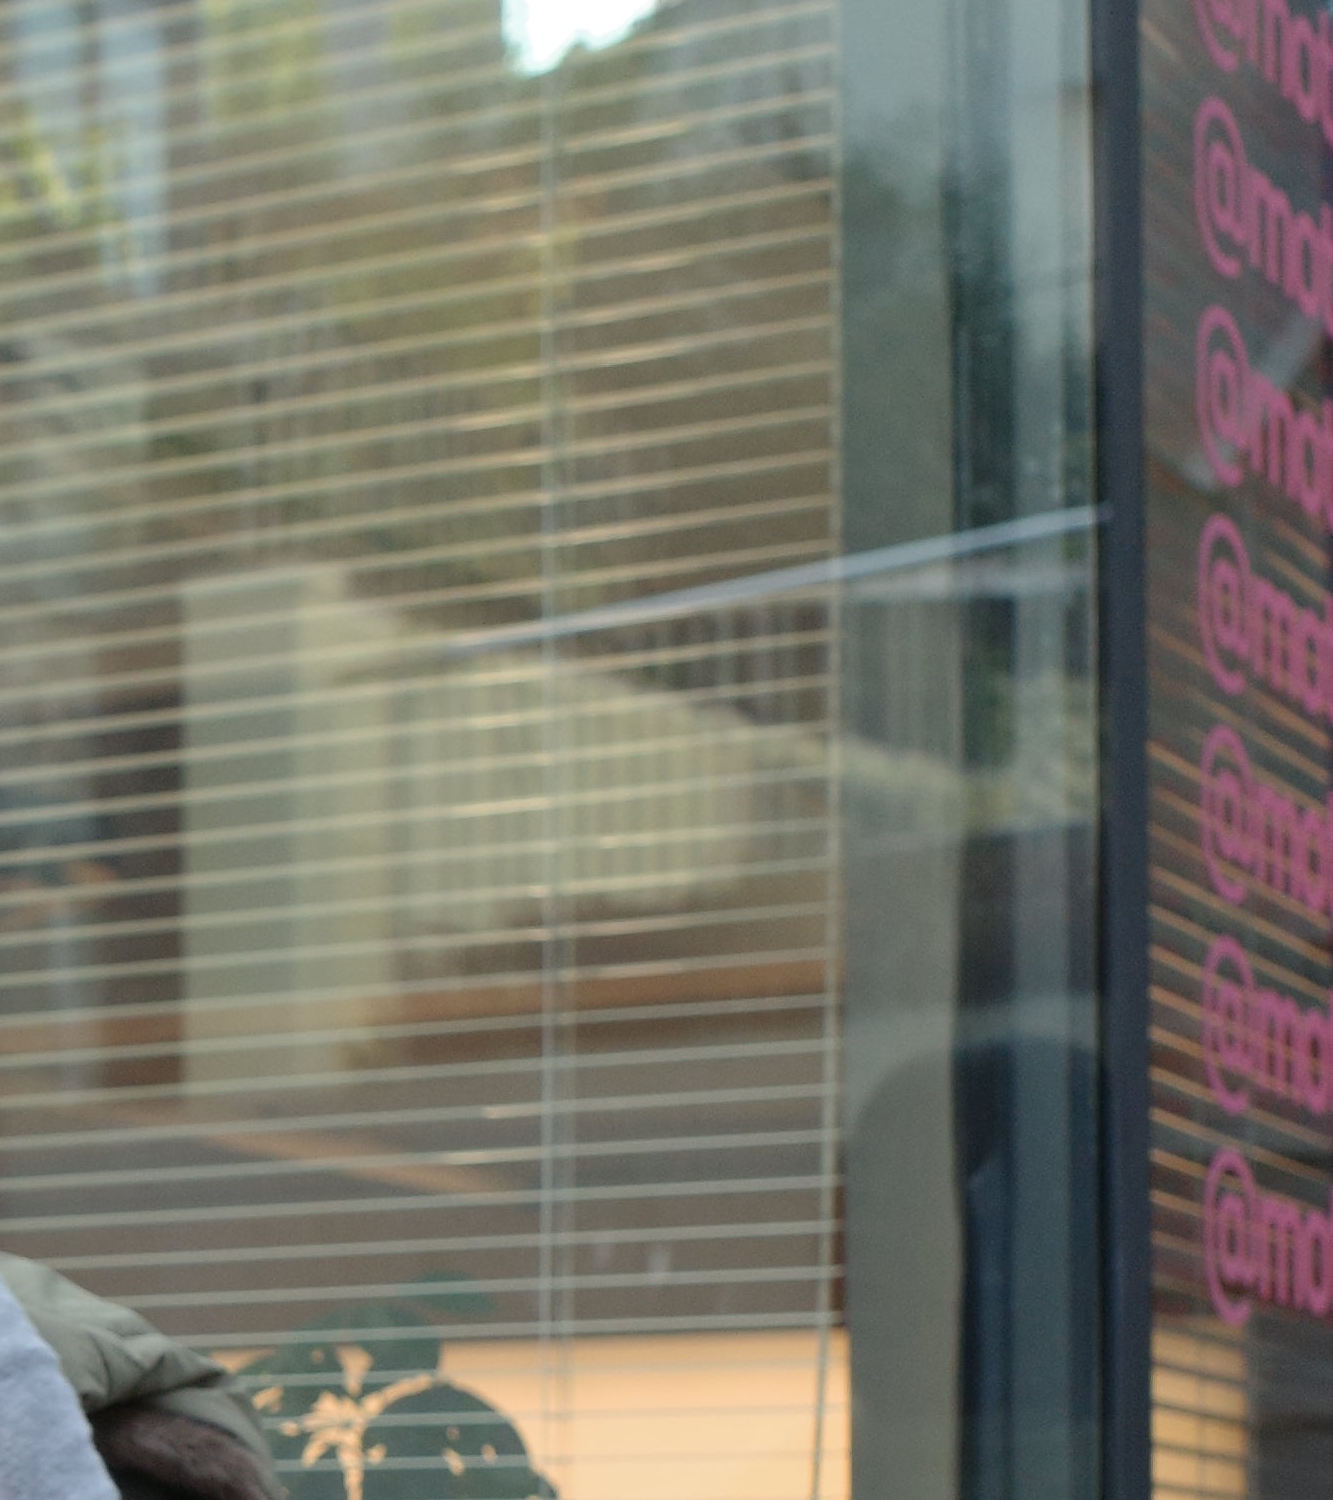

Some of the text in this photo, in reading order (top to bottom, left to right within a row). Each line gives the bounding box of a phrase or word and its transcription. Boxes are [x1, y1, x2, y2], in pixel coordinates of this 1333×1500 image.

[1201, 725, 1333, 918] @mo
[1203, 934, 1333, 1116] @mo
[1204, 1149, 1333, 1326] @mo
